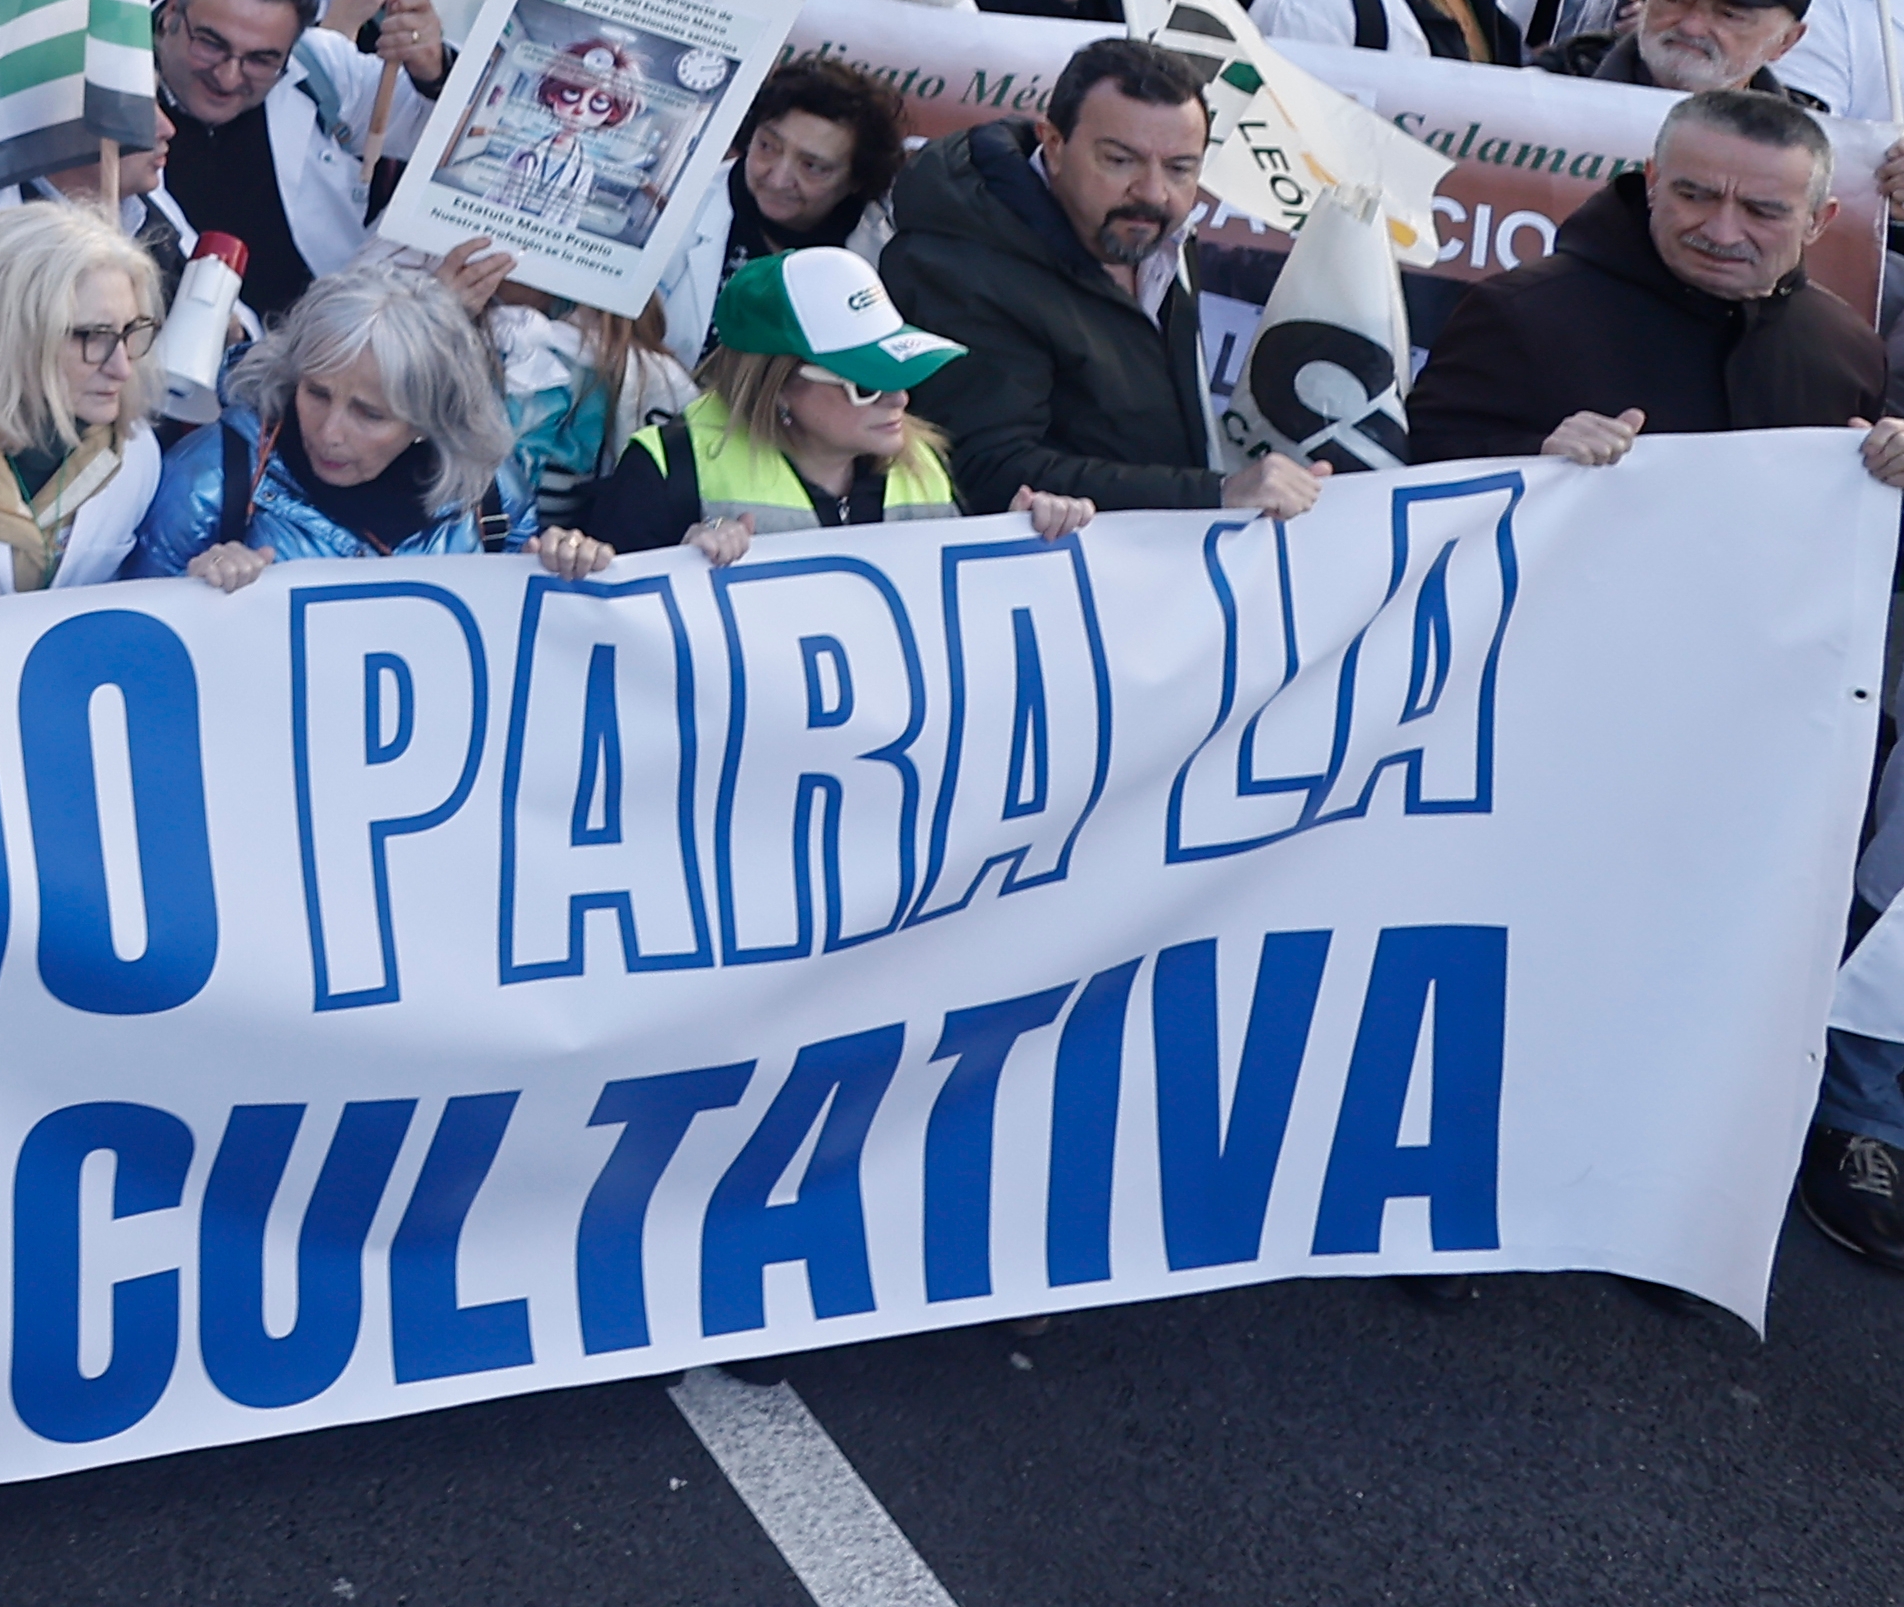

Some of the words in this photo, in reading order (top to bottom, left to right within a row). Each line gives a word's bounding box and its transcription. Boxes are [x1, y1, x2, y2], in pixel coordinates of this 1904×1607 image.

[583, 0, 610, 13] para
[611, 5, 686, 38] profesionales
[688, 31, 738, 53] sanitarios
[643, 2, 691, 23] Estatuto
[692, 16, 728, 35] Marco
[719, 9, 734, 22] de
[430, 206, 482, 233] Nuestra
[483, 224, 542, 254] Profesión
[544, 245, 558, 257] se
[577, 256, 625, 278] merece
[452, 196, 514, 227] Estatuto
[518, 216, 563, 242] Marco
[566, 230, 613, 258] Propio
[289, 537, 1114, 1012] PARA
[1164, 470, 1527, 866] LA
